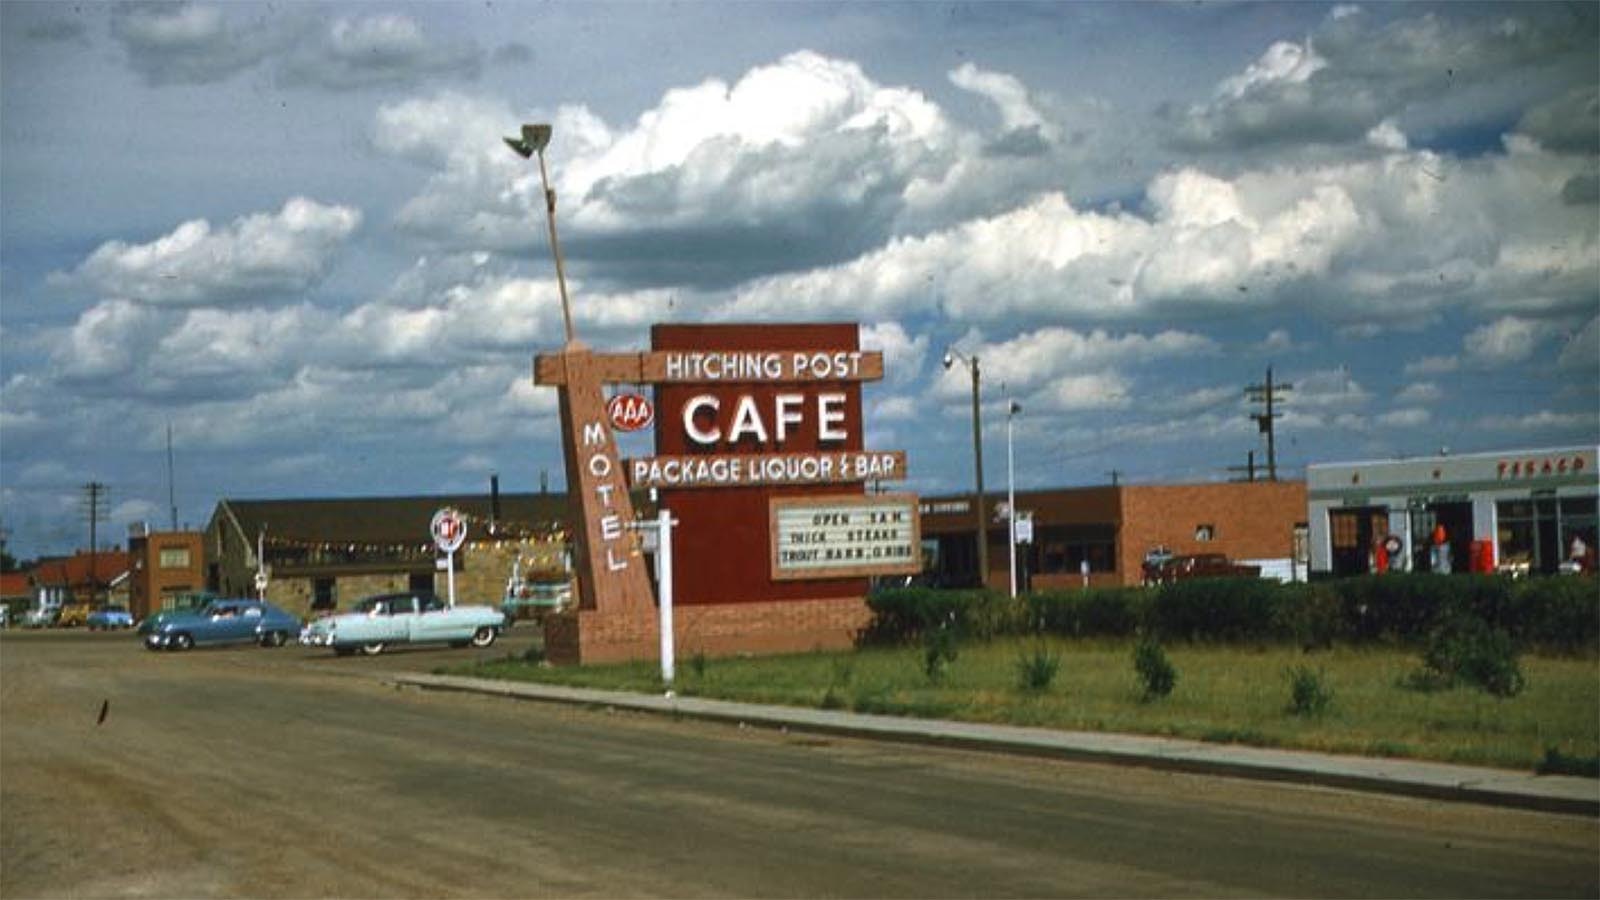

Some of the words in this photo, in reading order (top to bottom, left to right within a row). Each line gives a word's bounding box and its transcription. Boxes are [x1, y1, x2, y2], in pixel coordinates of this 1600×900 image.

[666, 352, 782, 379] HITCHING
[793, 351, 861, 378] POST
[612, 397, 648, 424] AAA
[682, 393, 848, 444] CAFE
[634, 458, 742, 484] PACKAGE
[749, 456, 834, 481] LIQUOR
[855, 453, 896, 478] BAR
[583, 421, 628, 572] MOTEL
[812, 512, 849, 526] OPEN
